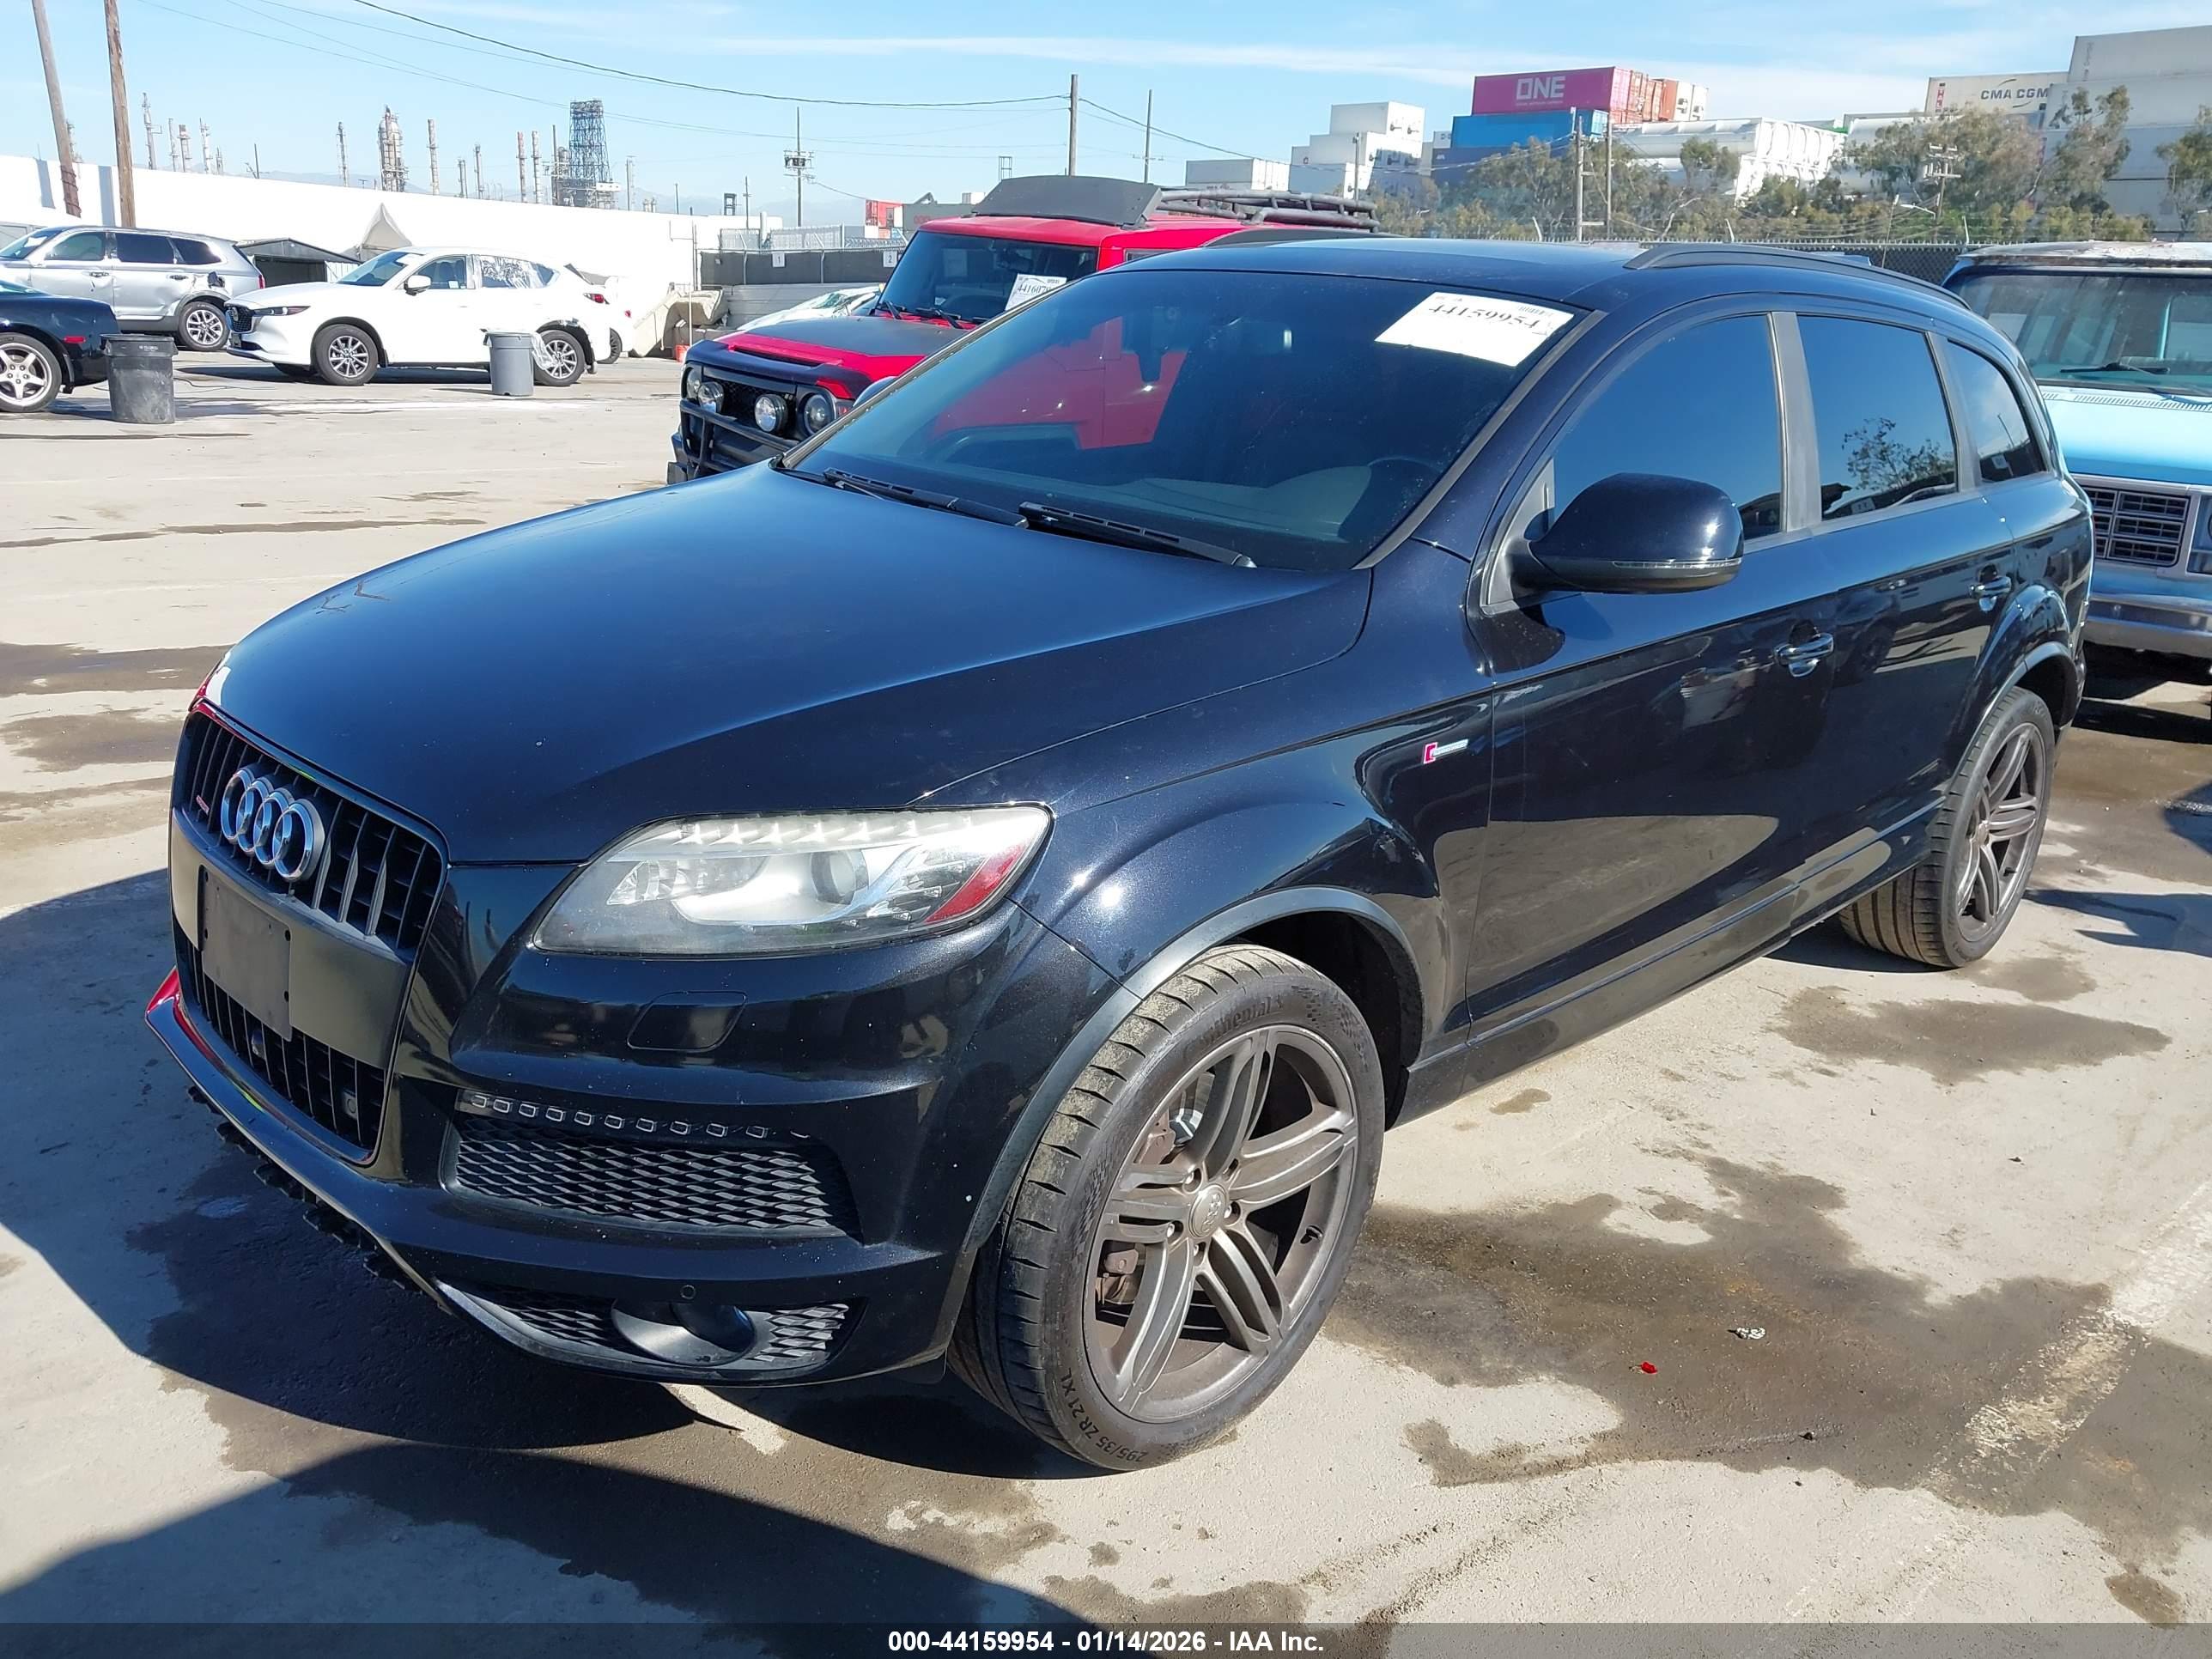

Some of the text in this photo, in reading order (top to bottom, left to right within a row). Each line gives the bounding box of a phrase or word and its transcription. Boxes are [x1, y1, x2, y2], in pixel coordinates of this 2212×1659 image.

[1516, 76, 1565, 100] ONE
[1981, 88, 2049, 100] CMA CGM
[888, 254, 893, 264] 2
[1429, 304, 1540, 329] 44159954
[1060, 1367, 1149, 1462] 295/35 ZR 21 XL
